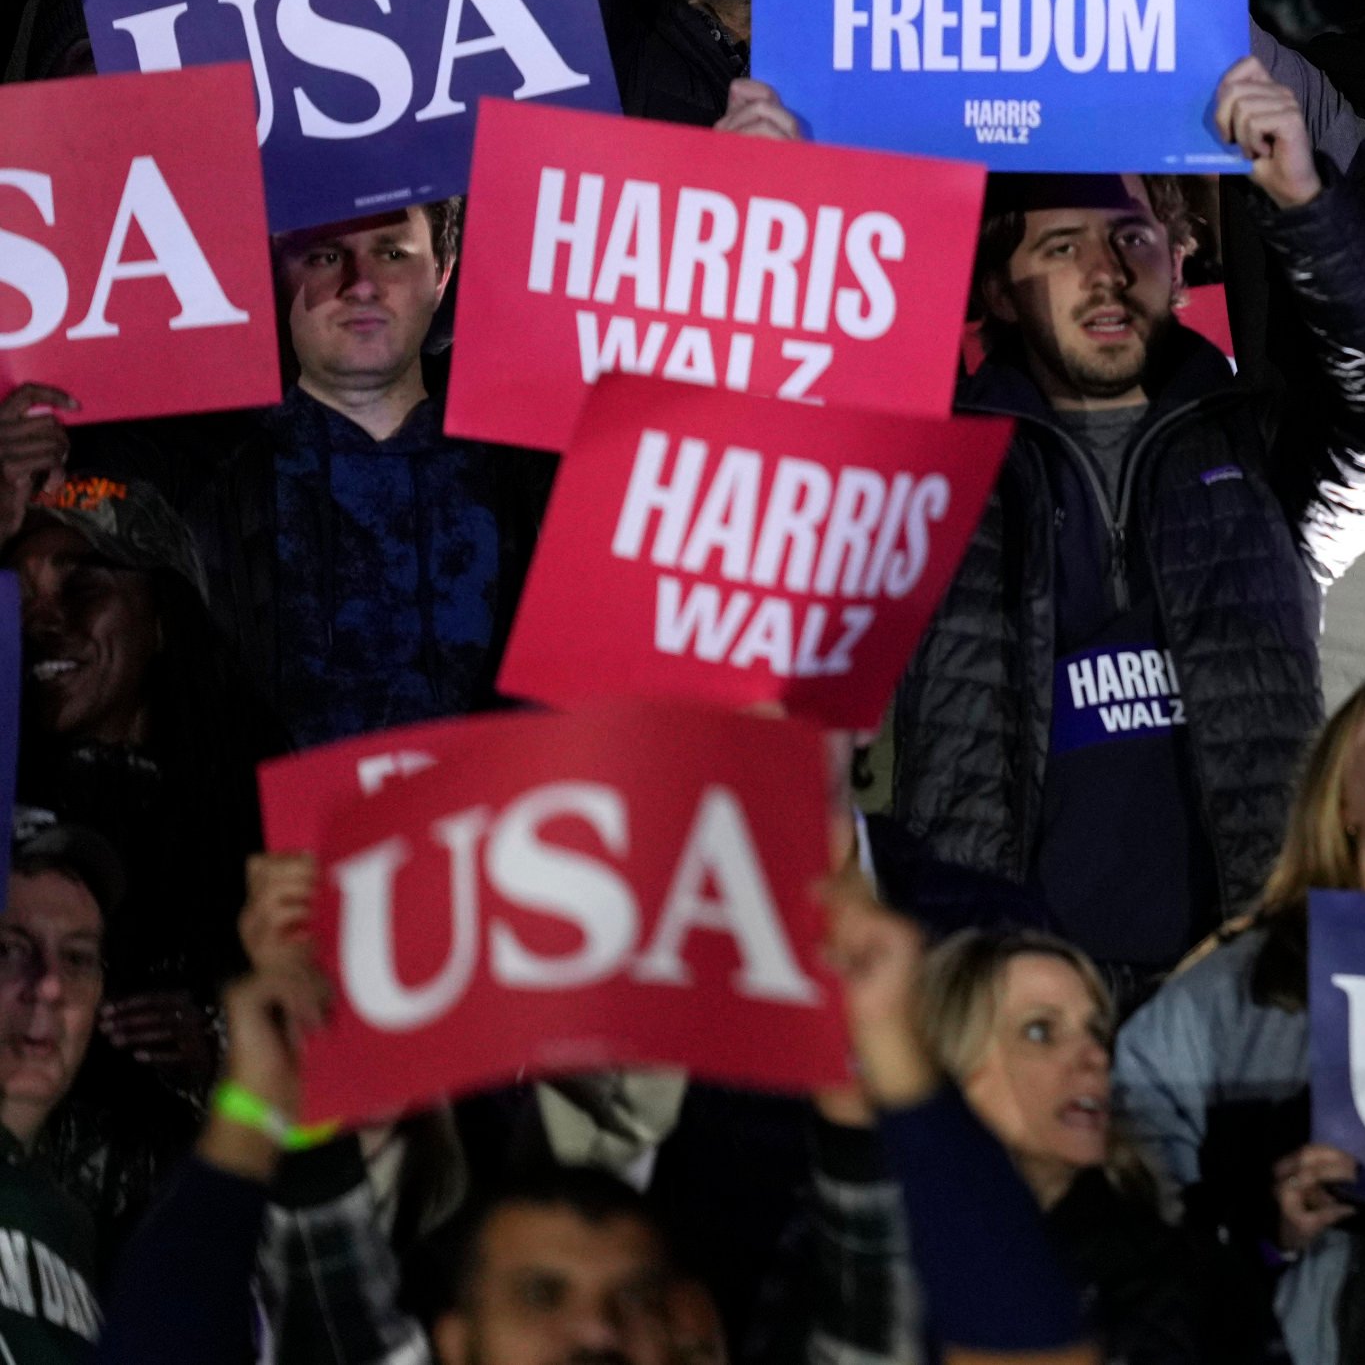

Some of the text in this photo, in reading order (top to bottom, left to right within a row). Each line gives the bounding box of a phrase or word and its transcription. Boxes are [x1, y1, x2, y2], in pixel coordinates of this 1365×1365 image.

[965, 100, 1041, 129] HARRIS
[976, 128, 1030, 144] WALZ
[527, 167, 905, 340] HARRIS
[612, 429, 951, 599] HARRIS
[654, 577, 875, 677] WALZ
[1067, 648, 1180, 710] HARRI
[1098, 698, 1186, 733] WALZ
[332, 780, 827, 1033] USA
